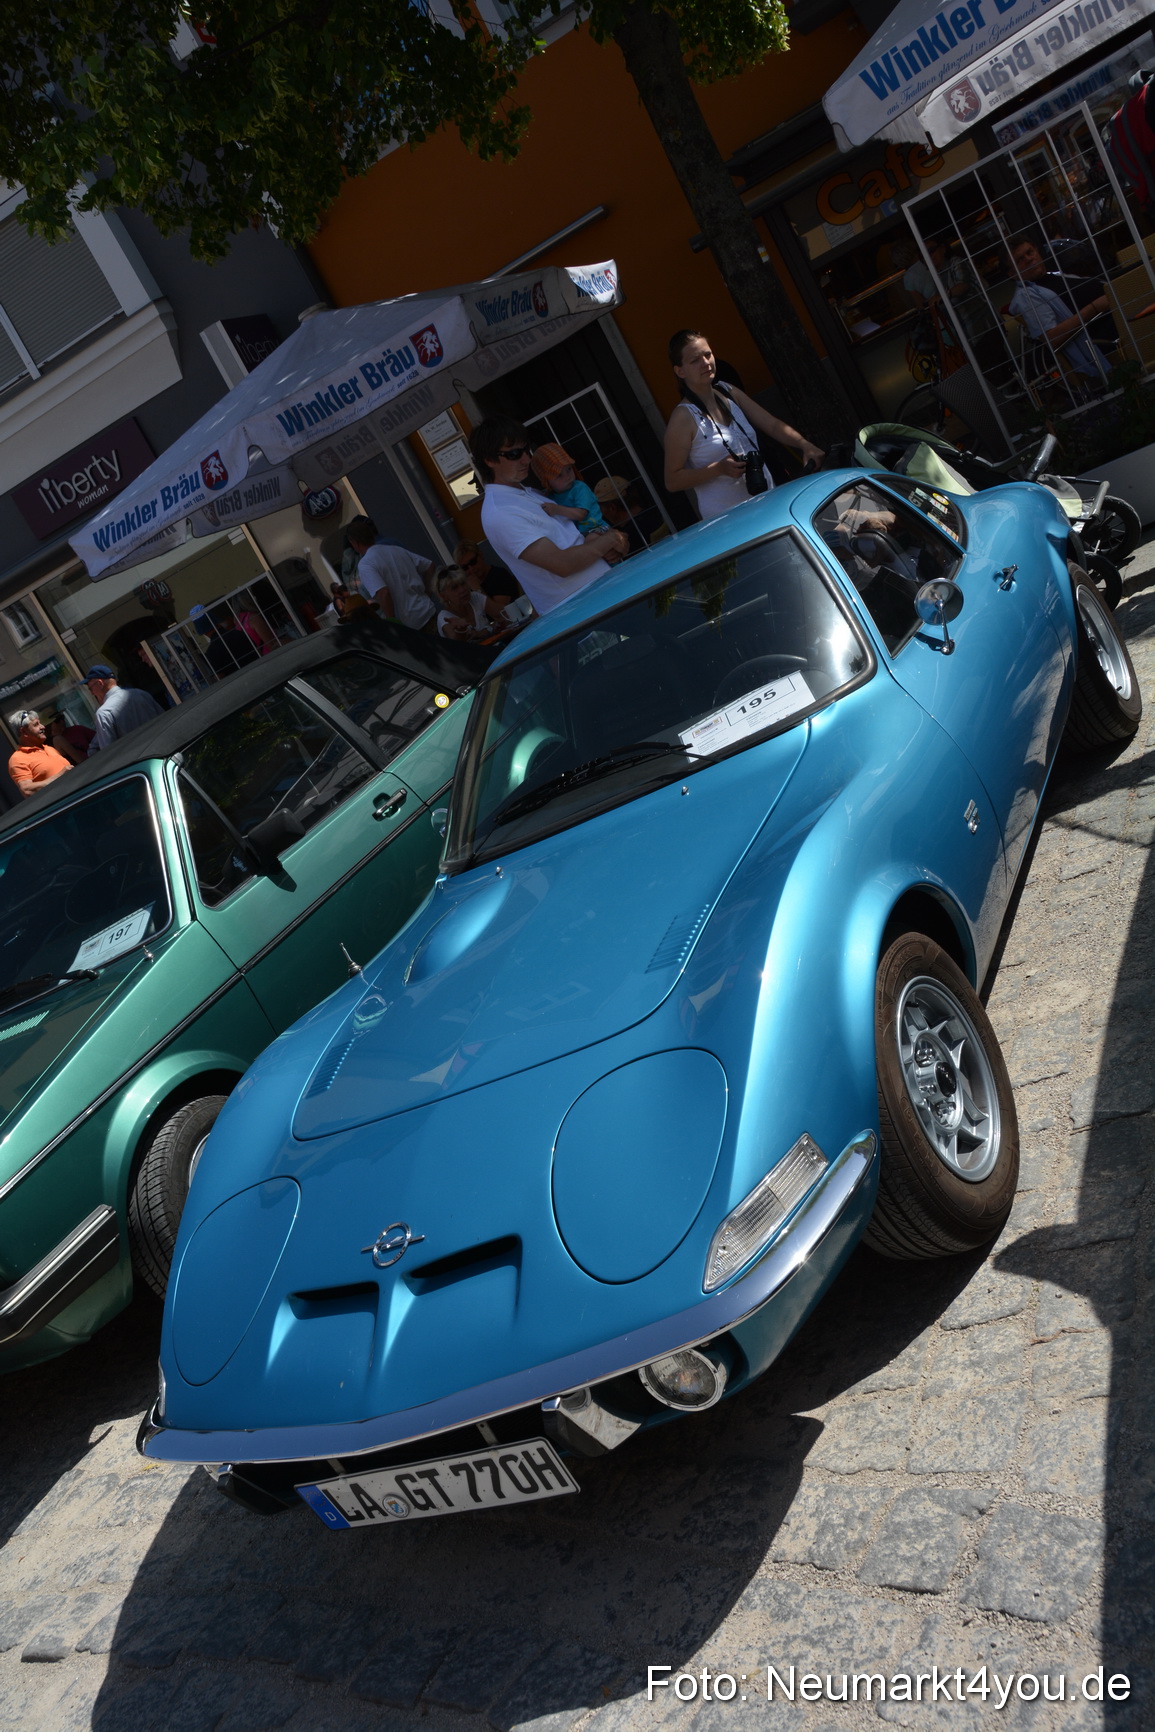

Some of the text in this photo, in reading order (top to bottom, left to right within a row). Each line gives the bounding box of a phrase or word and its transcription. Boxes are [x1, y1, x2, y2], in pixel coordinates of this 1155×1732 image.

[858, 0, 986, 101] Winkler
[276, 375, 364, 437] Winkler
[359, 345, 415, 390] Bräu
[38, 449, 121, 514] liberty
[77, 484, 109, 509] woman
[92, 497, 158, 552] Winkler
[160, 470, 201, 511] Bräu
[736, 688, 777, 715] 195
[108, 923, 133, 944] 197
[322, 1482, 388, 1522] LA
[394, 1468, 454, 1511] GT
[326, 1510, 337, 1521] D
